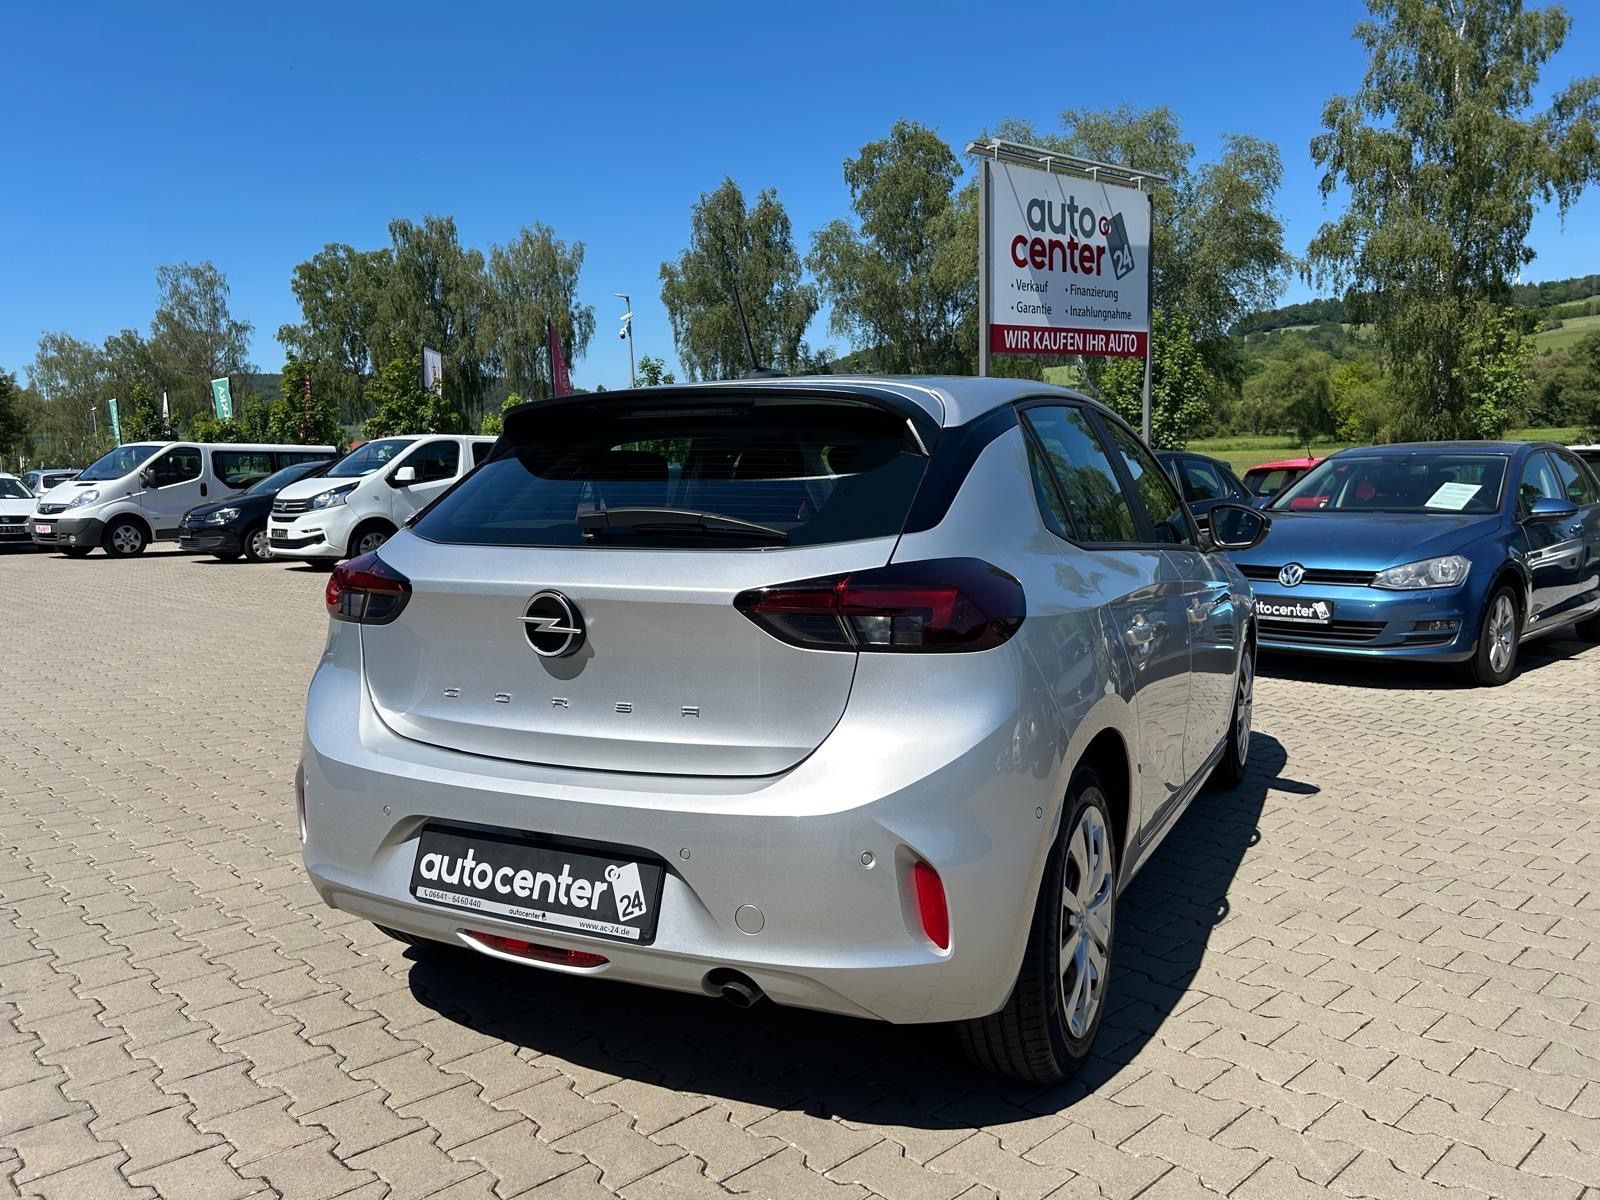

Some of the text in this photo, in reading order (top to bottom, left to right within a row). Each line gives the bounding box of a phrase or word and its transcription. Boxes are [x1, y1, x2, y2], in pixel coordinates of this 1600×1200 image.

[1027, 195, 1096, 238] auto
[1011, 234, 1105, 276] center
[1113, 243, 1132, 276] 24
[1016, 278, 1048, 293] Verkauf
[1070, 284, 1118, 302] Finanzierung
[1017, 301, 1052, 315] Garantie
[1070, 305, 1132, 321] Inzahlungnahme
[1004, 329, 1137, 353] WIR KAUFEN IHR AUTO
[443, 687, 701, 718] CORSA
[419, 848, 608, 911] autocenter
[508, 908, 541, 920] autocenter
[619, 890, 644, 918] 24
[579, 921, 630, 936] www.ac-24.de
